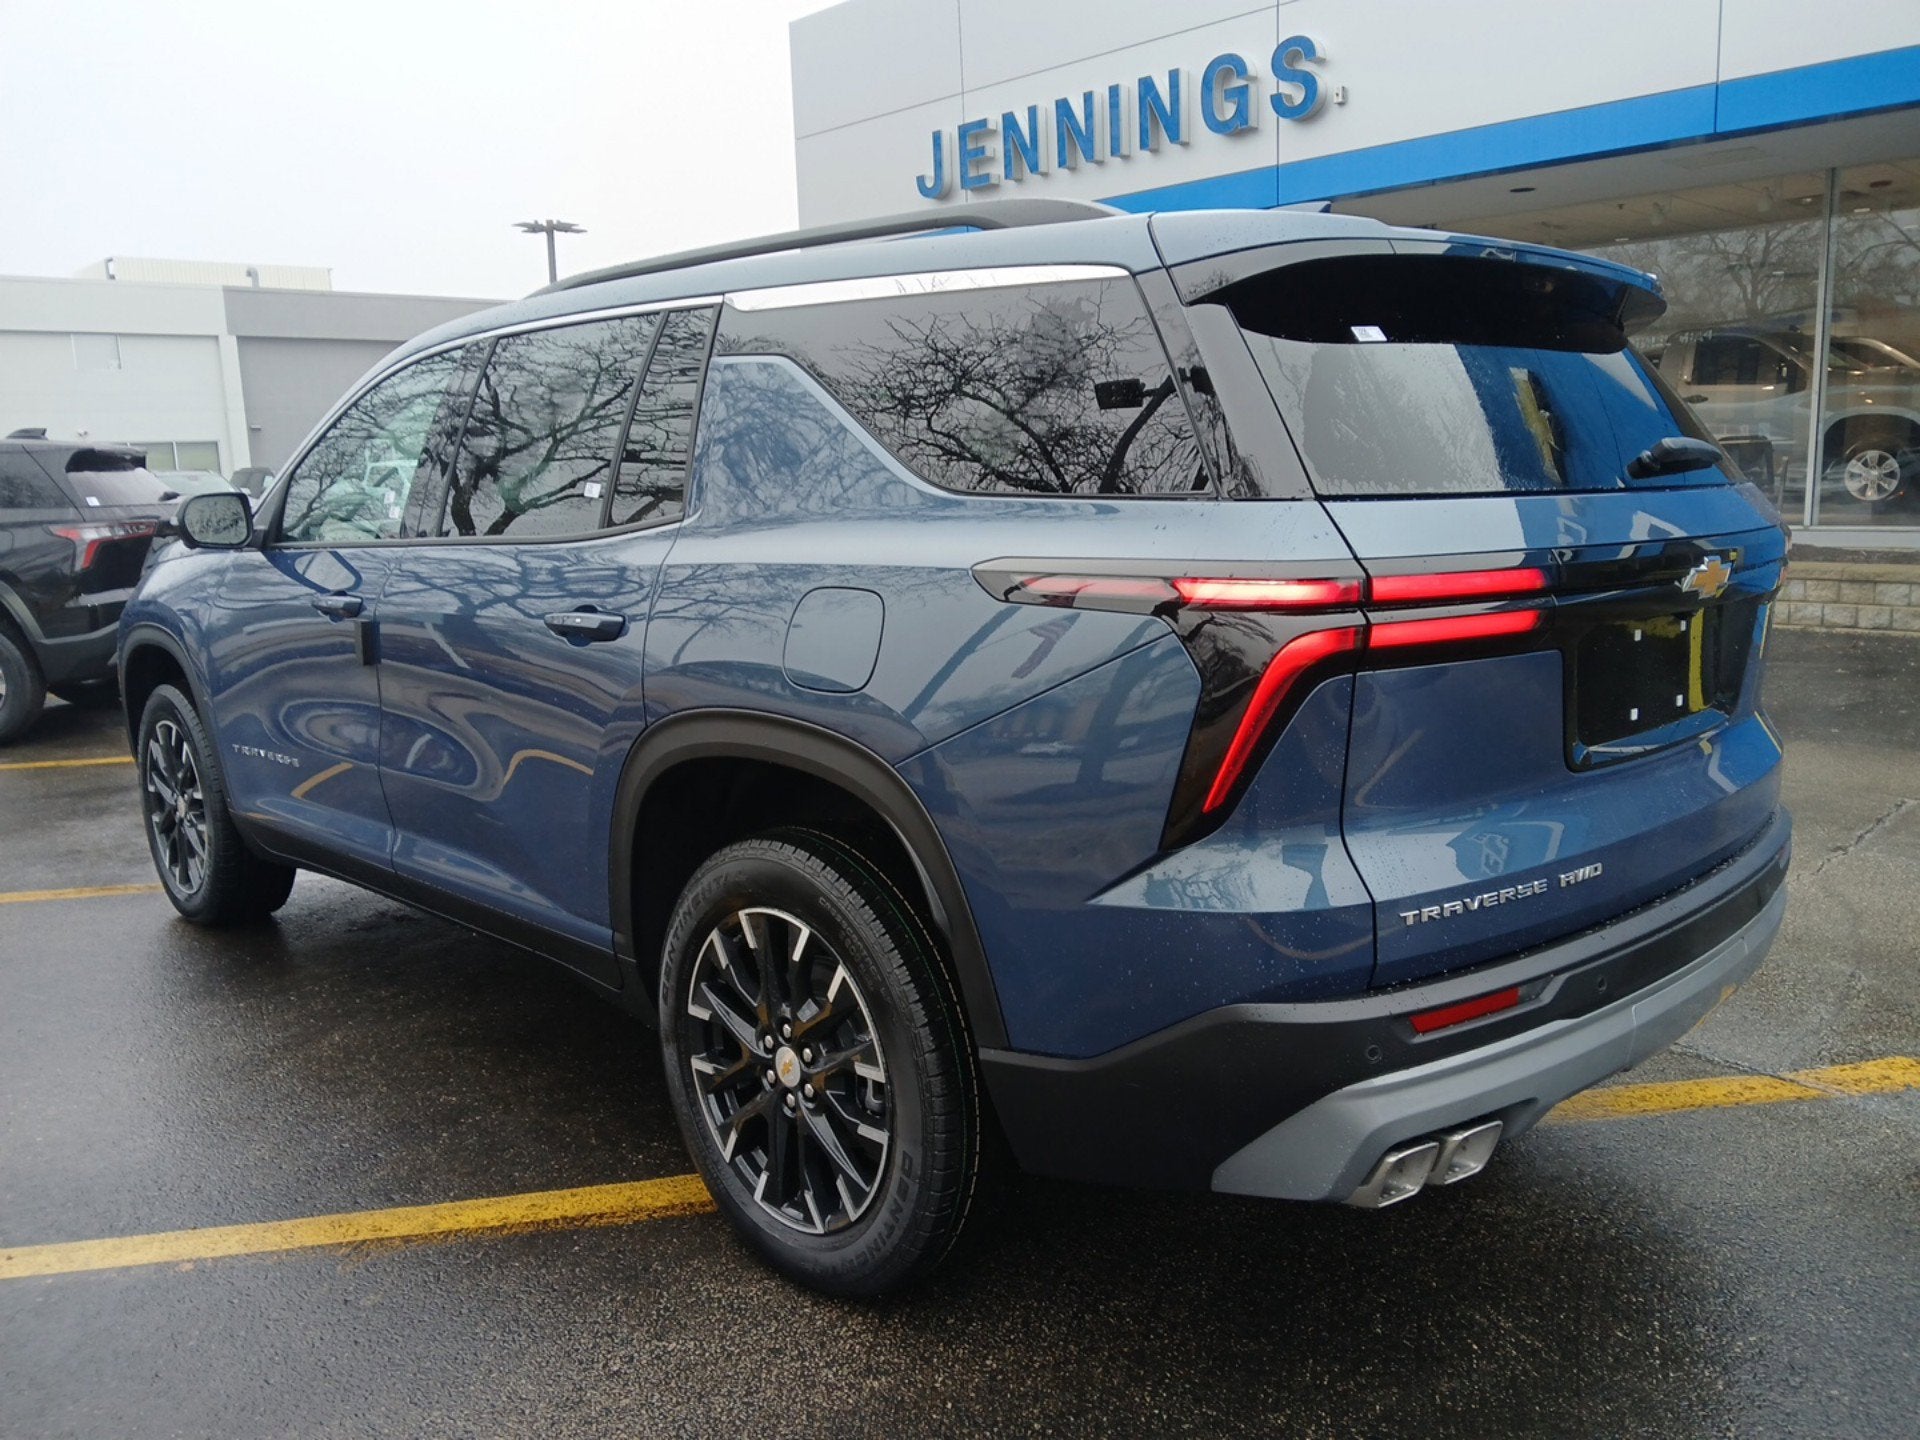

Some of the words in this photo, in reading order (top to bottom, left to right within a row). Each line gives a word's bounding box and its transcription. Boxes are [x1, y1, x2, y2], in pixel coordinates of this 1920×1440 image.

[915, 34, 1328, 200] JENNINGS
[232, 743, 299, 767] TRAVERSE
[1399, 878, 1548, 926] TRAVERSE
[1559, 861, 1604, 888] AWD
